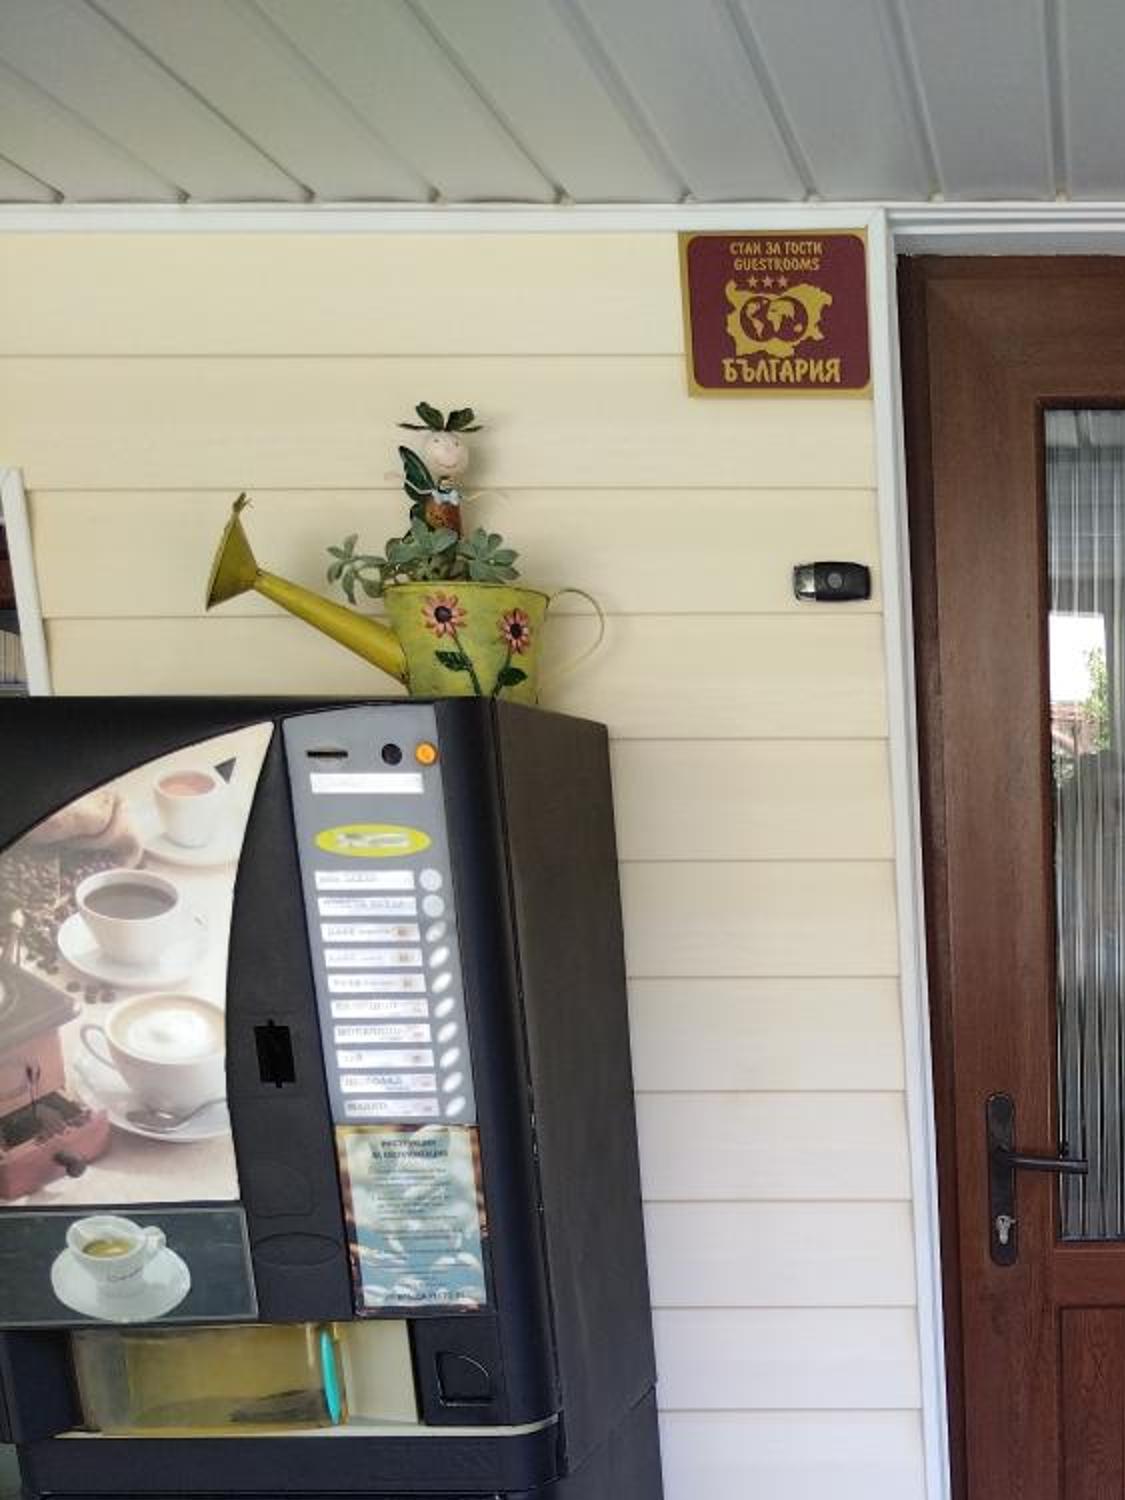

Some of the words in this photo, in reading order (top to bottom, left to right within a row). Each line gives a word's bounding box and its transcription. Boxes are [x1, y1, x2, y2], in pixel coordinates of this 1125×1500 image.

[729, 241, 761, 256] СТАИ
[766, 241, 780, 255] ЗА
[784, 240, 823, 255] ГОСТИ
[734, 257, 820, 272] GUESTROOMS
[722, 358, 841, 383] БЪЛГАРИЯ
